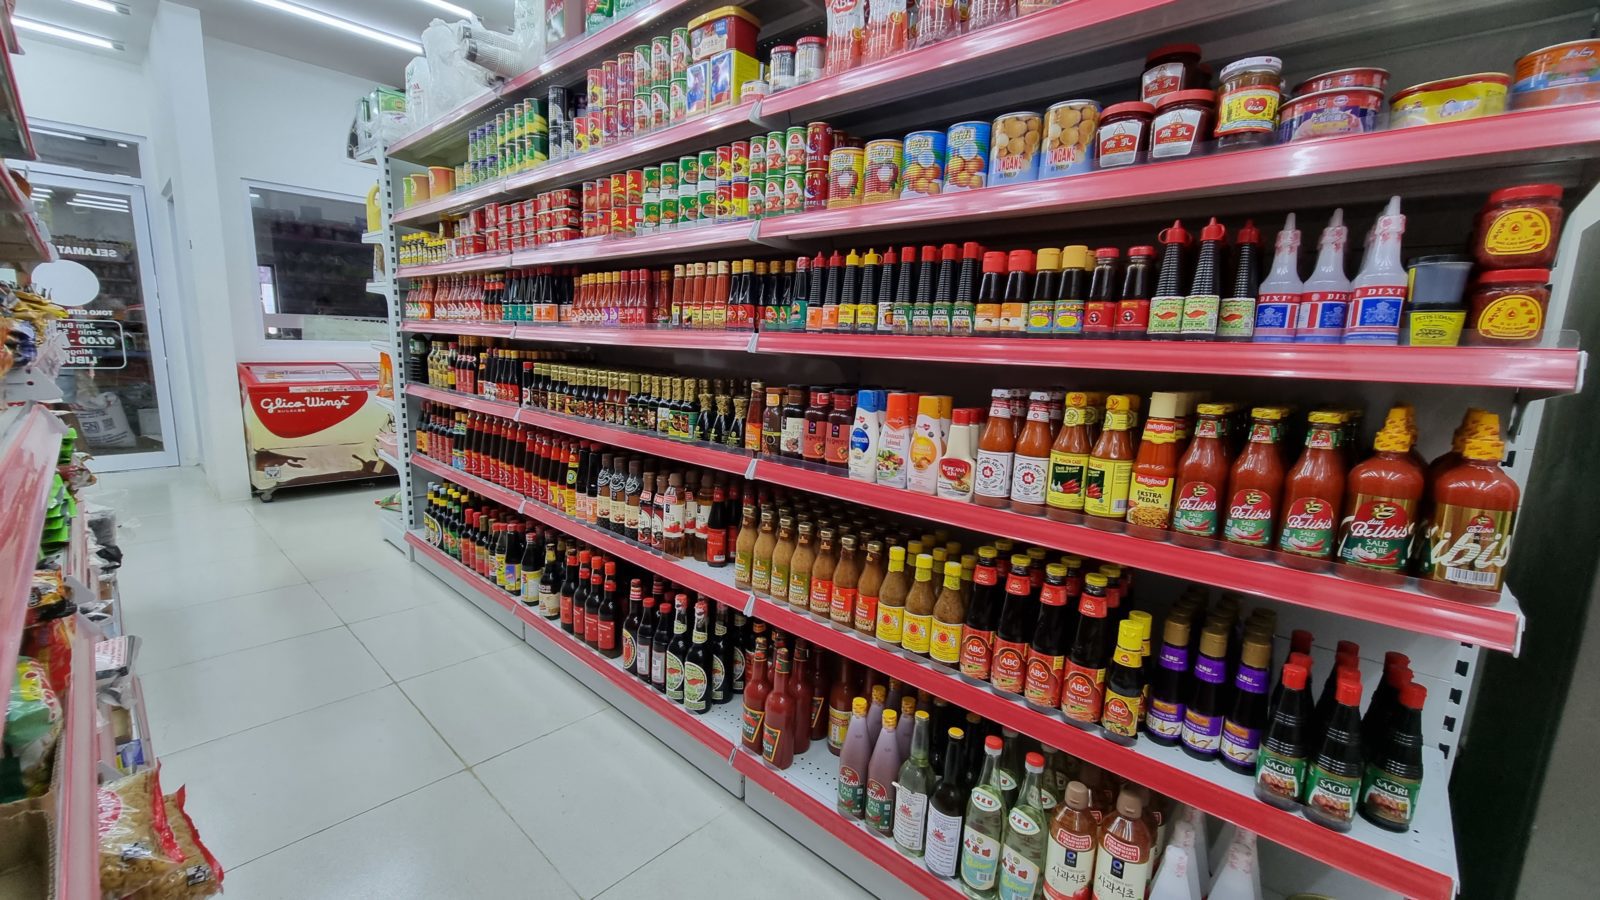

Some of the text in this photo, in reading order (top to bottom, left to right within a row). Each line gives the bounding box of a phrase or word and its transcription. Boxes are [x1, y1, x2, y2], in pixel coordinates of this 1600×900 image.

[1367, 288, 1402, 296] DIXI
[260, 398, 304, 414] Glico
[304, 396, 350, 409] Wings
[1146, 424, 1174, 432] Indofood
[1137, 475, 1166, 486] Indofood
[1137, 490, 1162, 499] EKSTRA
[1137, 497, 1160, 505] PEDAS
[1179, 498, 1217, 511] Belibis
[1230, 506, 1271, 519] Belibis
[1287, 516, 1332, 530] Belibis
[1351, 521, 1408, 539] Belibis
[968, 645, 984, 656] ABC
[1001, 657, 1018, 668] ABC
[1030, 668, 1046, 679] ABC
[1071, 682, 1089, 693] ABC
[1110, 704, 1126, 715] ABC
[1265, 759, 1295, 775] SAORI
[1320, 779, 1351, 796] SAORI
[1376, 778, 1409, 796] SAORI
[1051, 866, 1087, 884] 사과식초
[1098, 875, 1135, 899] 사과식초
